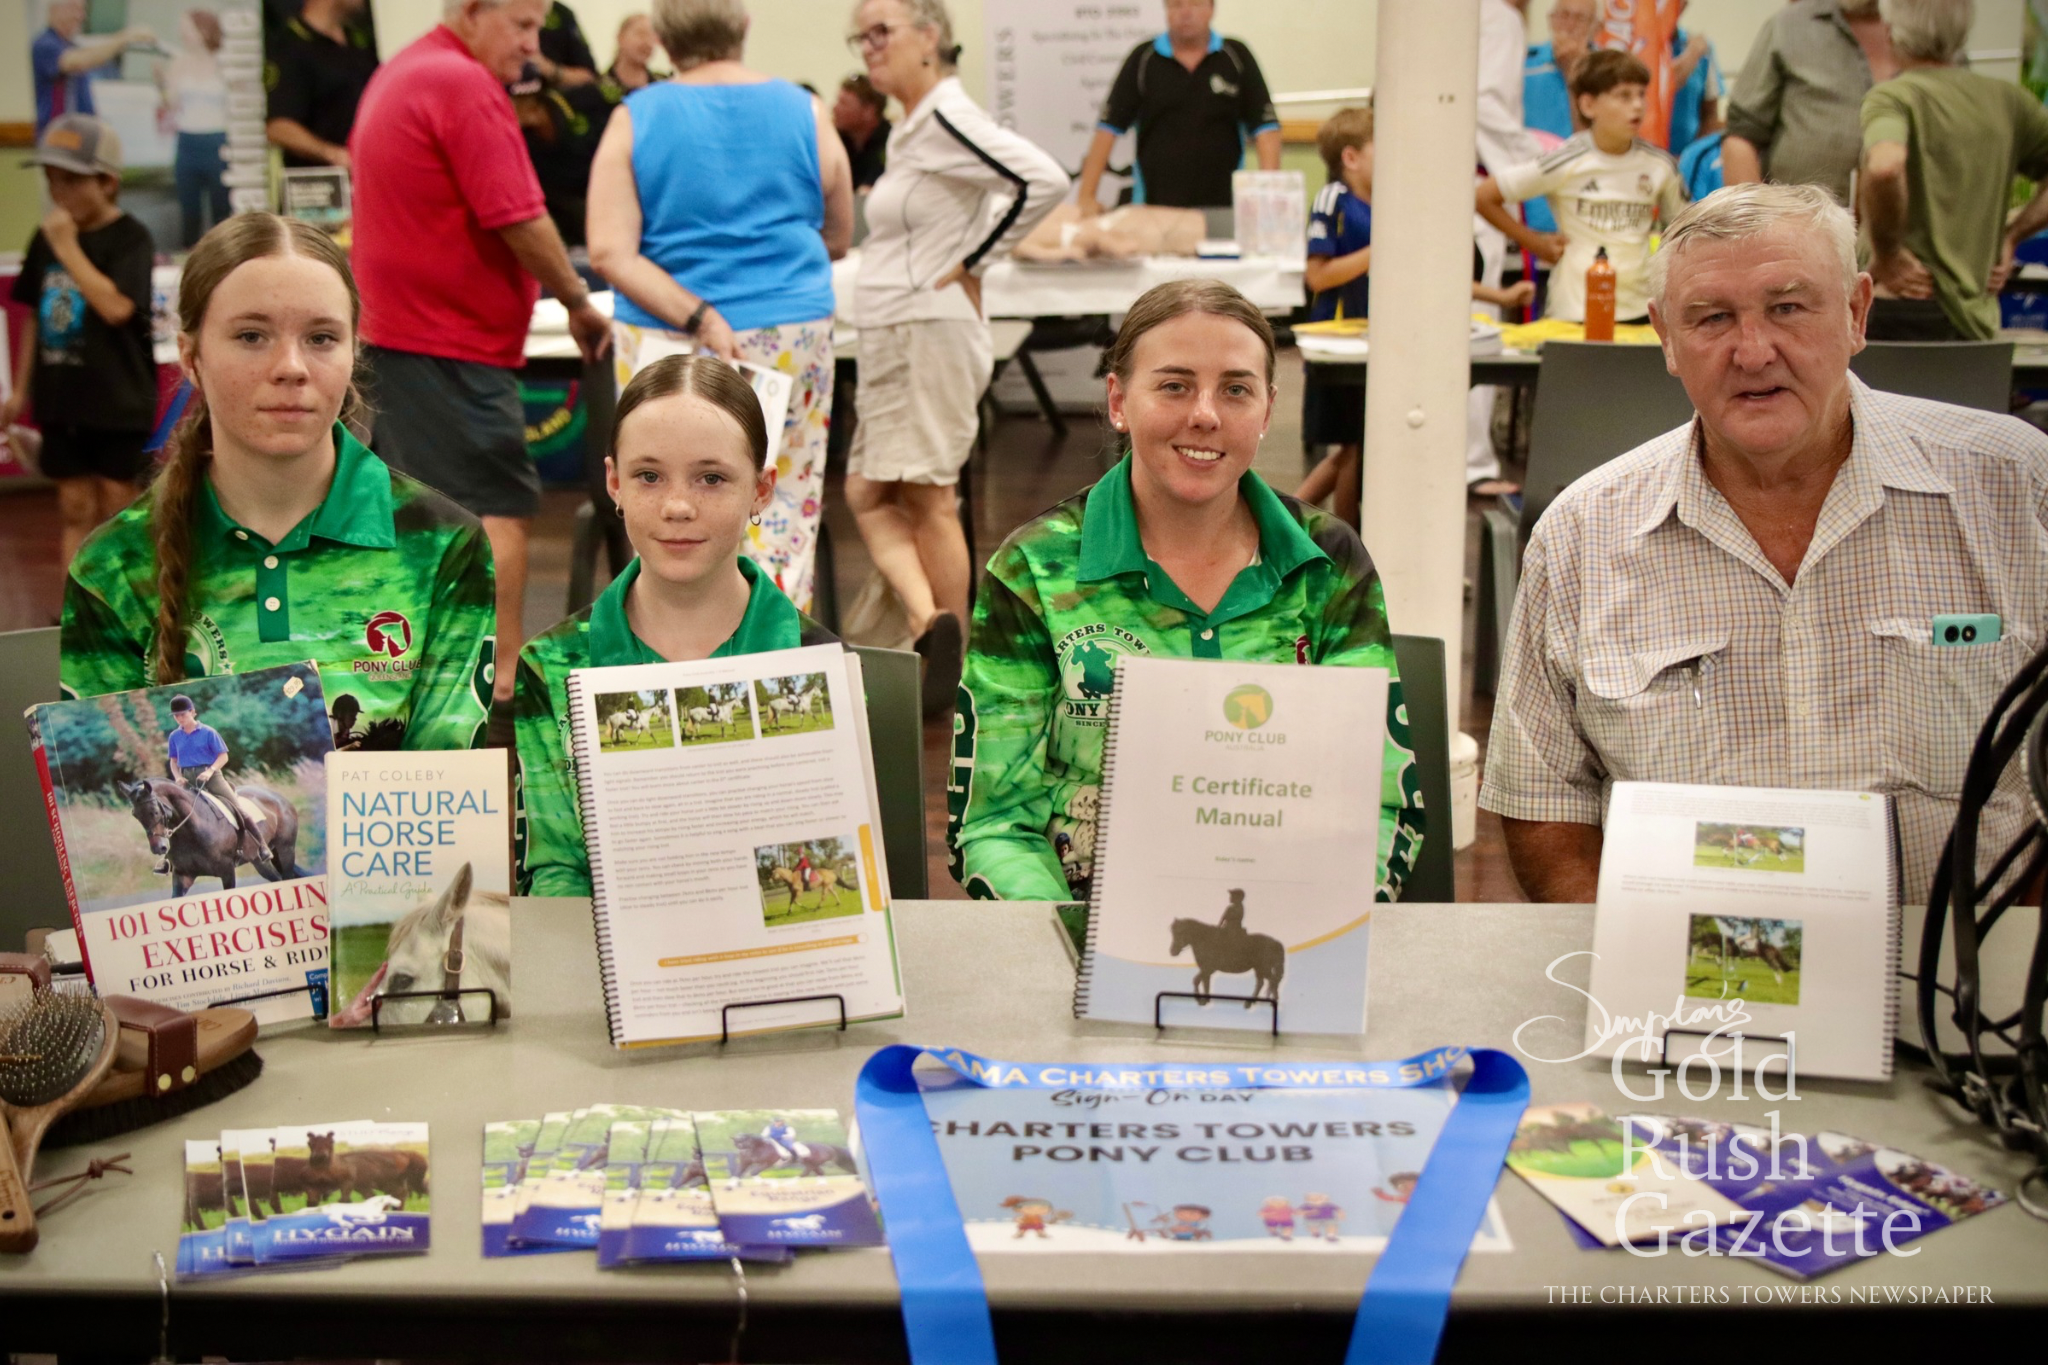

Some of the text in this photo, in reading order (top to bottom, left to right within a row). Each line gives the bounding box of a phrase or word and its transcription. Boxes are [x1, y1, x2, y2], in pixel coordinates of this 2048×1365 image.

[996, 27, 1015, 131] OWERS
[1114, 627, 1151, 655] TOW
[354, 660, 423, 673] PONY CLUB
[1066, 702, 1101, 717] ONY
[1205, 730, 1287, 745] PONY CLUB
[342, 770, 445, 783] PAT COLEBY
[1171, 775, 1313, 798] E Certificate
[342, 789, 498, 817] NATURAL
[1195, 807, 1283, 828] Manual
[342, 820, 456, 848] HORSE
[342, 851, 433, 878] CARE
[354, 880, 397, 895] Practical
[400, 881, 433, 900] Guide
[108, 881, 328, 942] 101 SCHOOLIN
[141, 915, 328, 969] EXERCISES
[129, 946, 328, 992] FOR HORSE & RID
[232, 979, 260, 991] Richard
[923, 1045, 1467, 1086] AMA CHARTERS TOWERS SHO
[1200, 1093, 1254, 1103] DAY
[1194, 1121, 1416, 1139] TOWERS
[1012, 1145, 1314, 1163] PONY CLUB
[273, 1225, 415, 1240] HYGAIN
